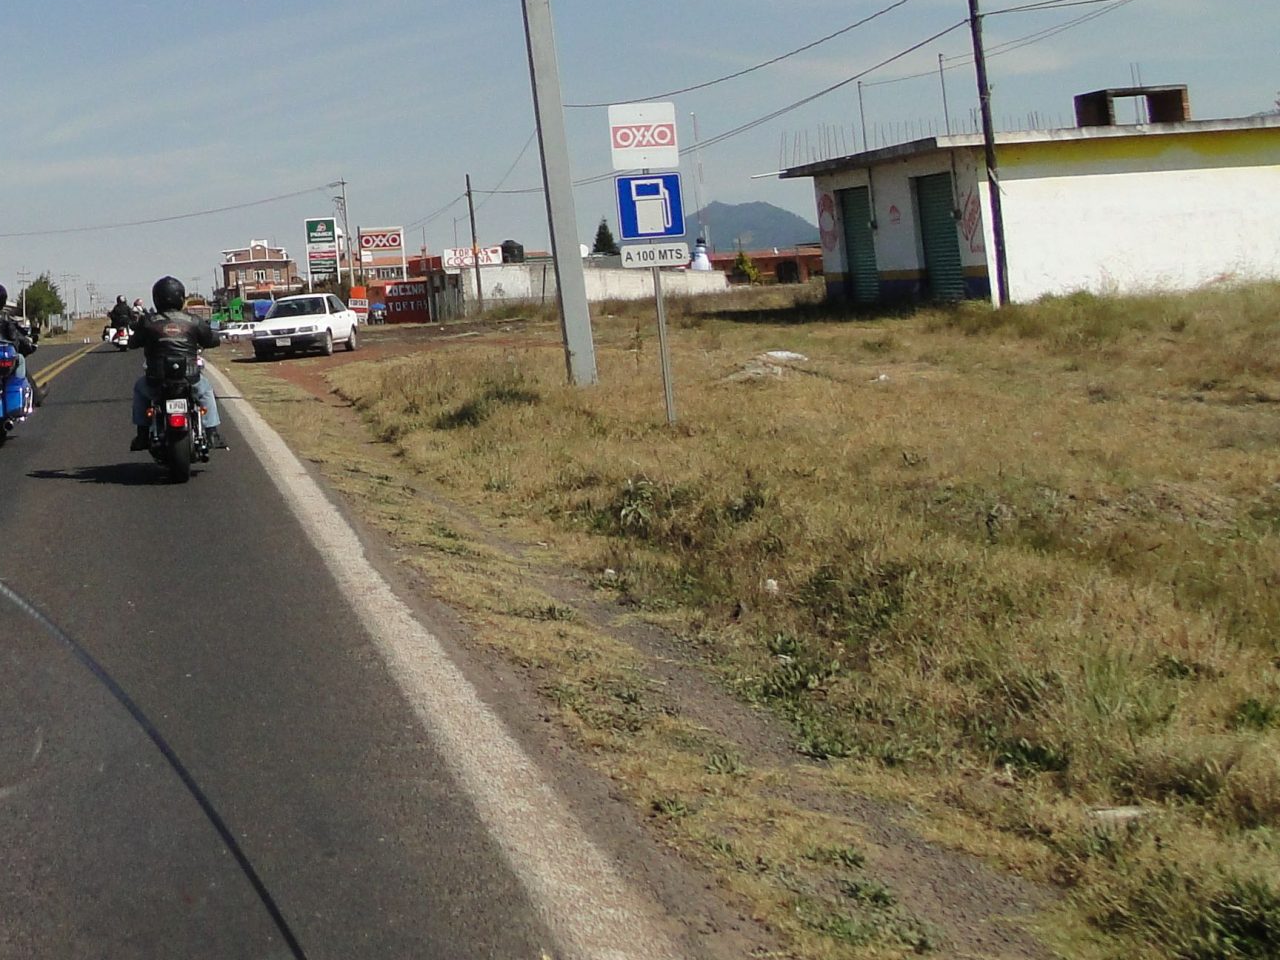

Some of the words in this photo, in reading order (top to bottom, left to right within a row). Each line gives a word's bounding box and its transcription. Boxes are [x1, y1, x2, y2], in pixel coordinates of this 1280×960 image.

[615, 125, 671, 148] OXXO
[361, 233, 400, 248] OXXO
[452, 248, 489, 257] TORAS
[625, 253, 633, 262] A
[636, 250, 655, 262] 100
[658, 248, 686, 260] MTS.
